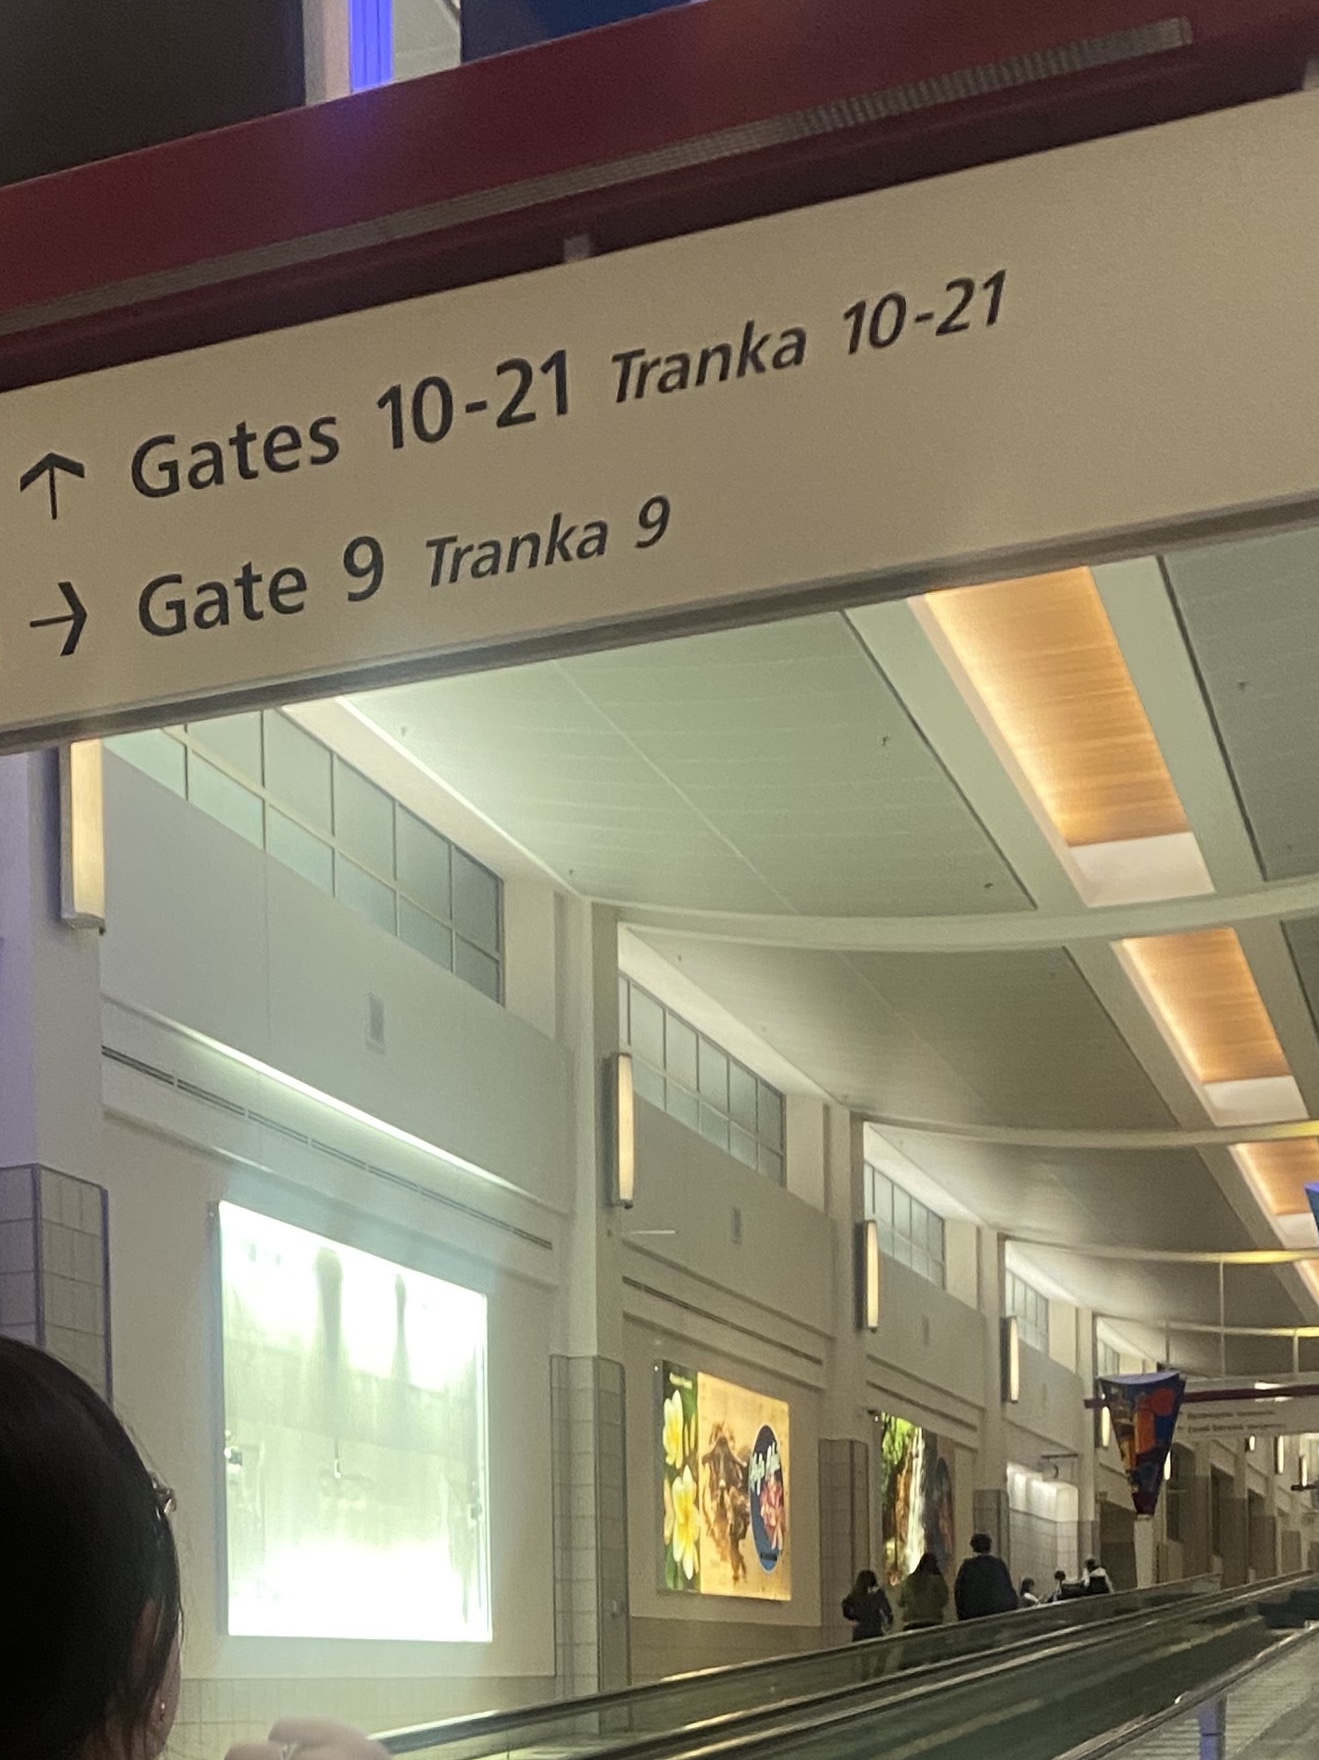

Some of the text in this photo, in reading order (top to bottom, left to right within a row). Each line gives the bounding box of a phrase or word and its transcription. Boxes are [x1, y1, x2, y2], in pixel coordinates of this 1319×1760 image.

[130, 268, 1007, 500] Gates 10-21 Tranka 10-21
[137, 494, 672, 639] Gate 9 Tranka 9
